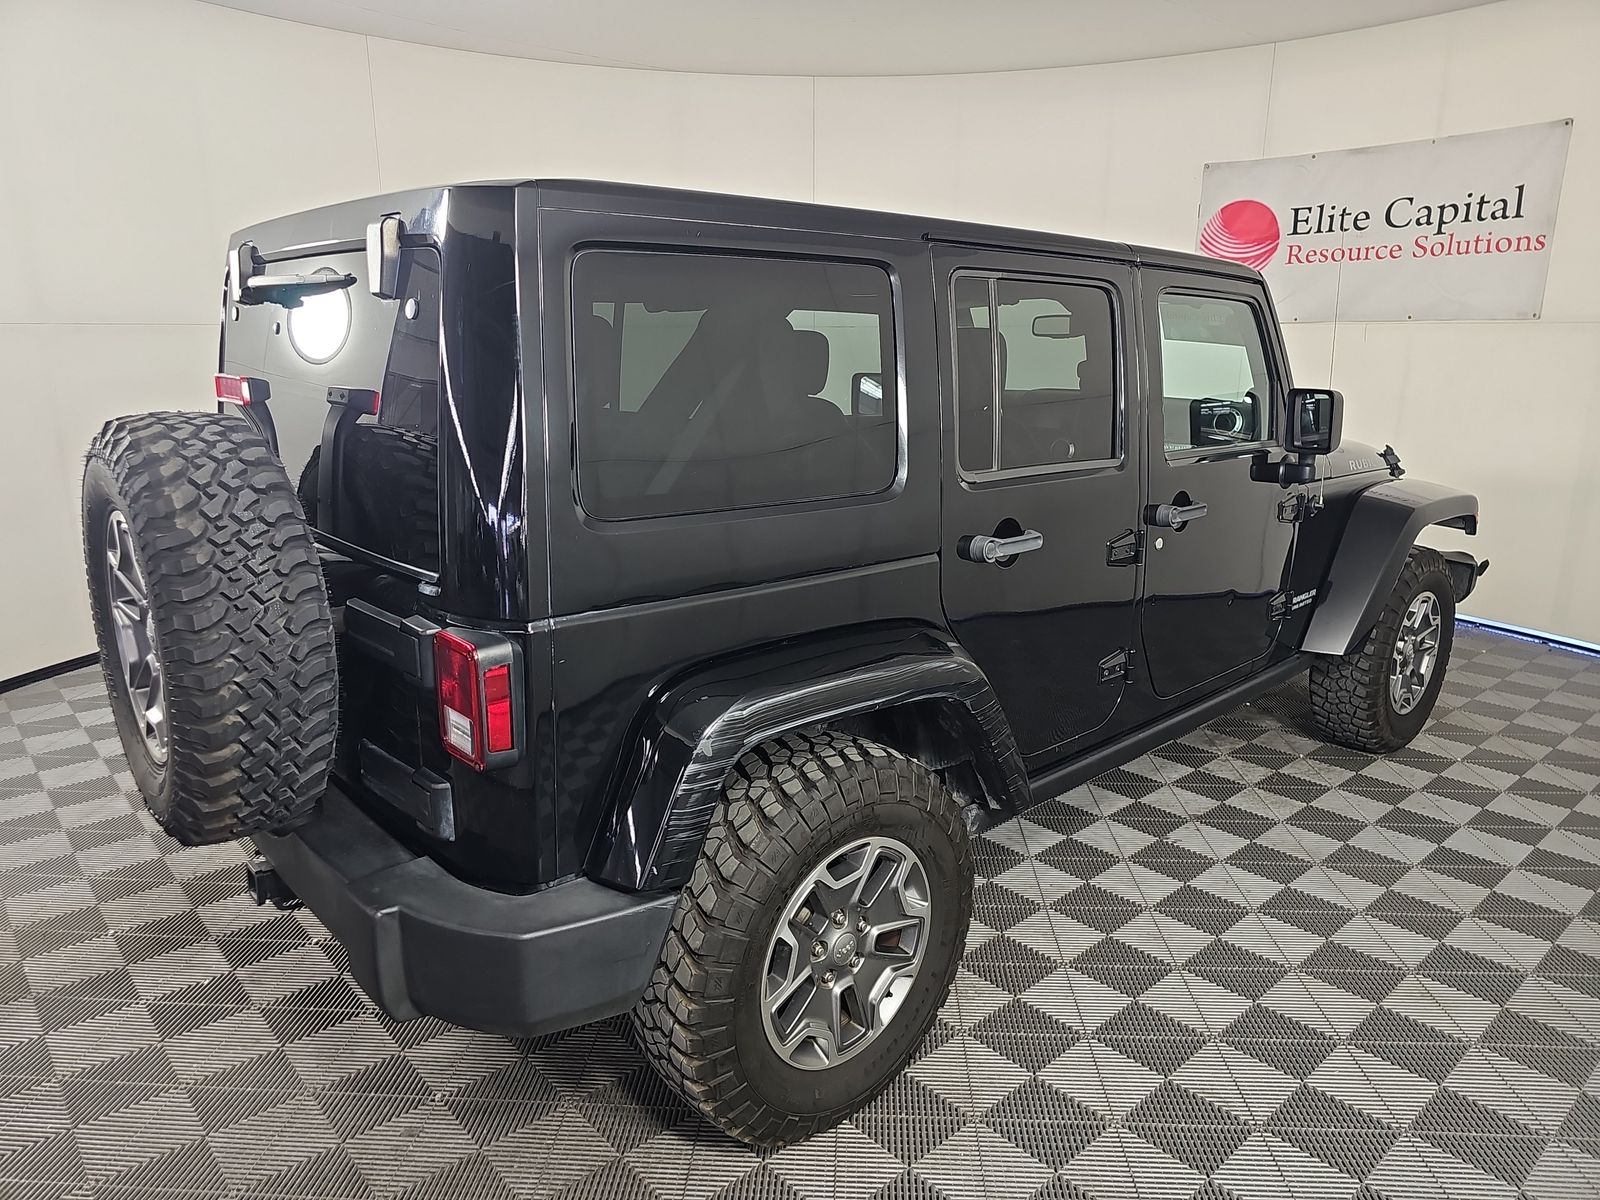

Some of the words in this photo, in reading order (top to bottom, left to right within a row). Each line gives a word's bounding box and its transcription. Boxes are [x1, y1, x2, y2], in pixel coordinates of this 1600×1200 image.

[1286, 203, 1370, 236] Elite
[1384, 183, 1525, 236] Capital
[1285, 242, 1403, 265] Resource
[1412, 231, 1547, 259] Solutions
